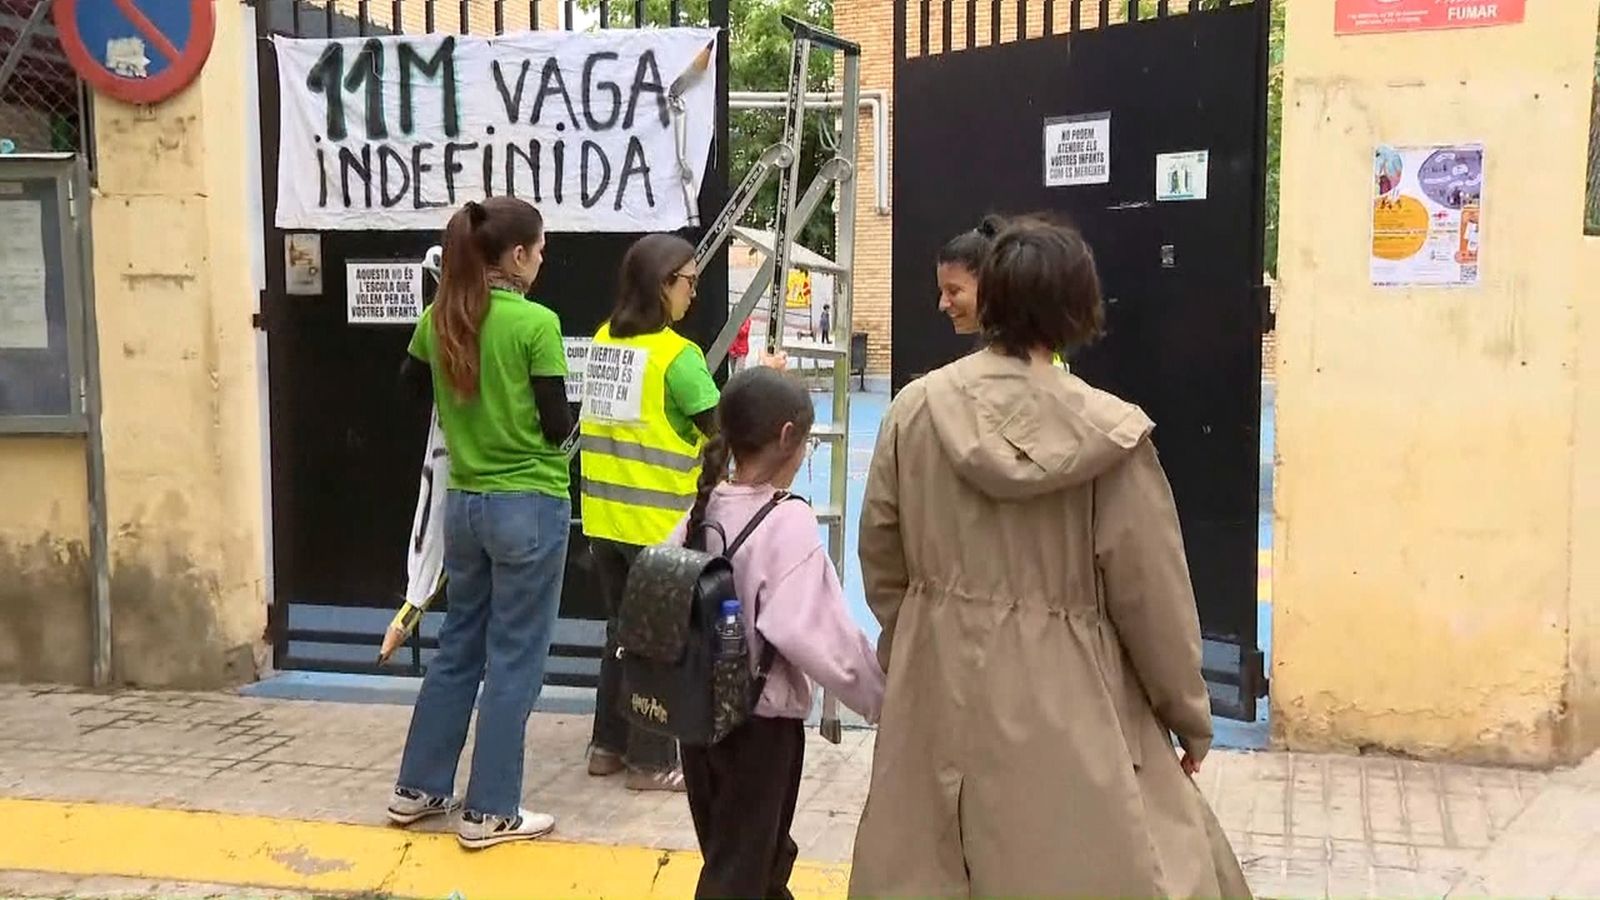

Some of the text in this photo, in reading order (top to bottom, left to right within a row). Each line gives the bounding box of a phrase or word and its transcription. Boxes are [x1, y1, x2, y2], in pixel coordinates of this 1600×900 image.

[1448, 5, 1497, 20] FUMAR
[306, 36, 670, 141] 11M VAGA
[1062, 128, 1094, 141] NO PODEM
[1058, 140, 1097, 153] ATENDRE ELS
[1051, 152, 1104, 167] VOSTRES INFANTS
[356, 266, 414, 280] AQUESTA NO ÉS
[359, 281, 411, 292] L'ESCOLA QUE
[356, 293, 415, 305] VOLEM PER ALS
[351, 306, 385, 318] VOSTRES
[622, 350, 635, 365] EN
[621, 366, 633, 383] ÉS
[616, 385, 629, 401] EN
